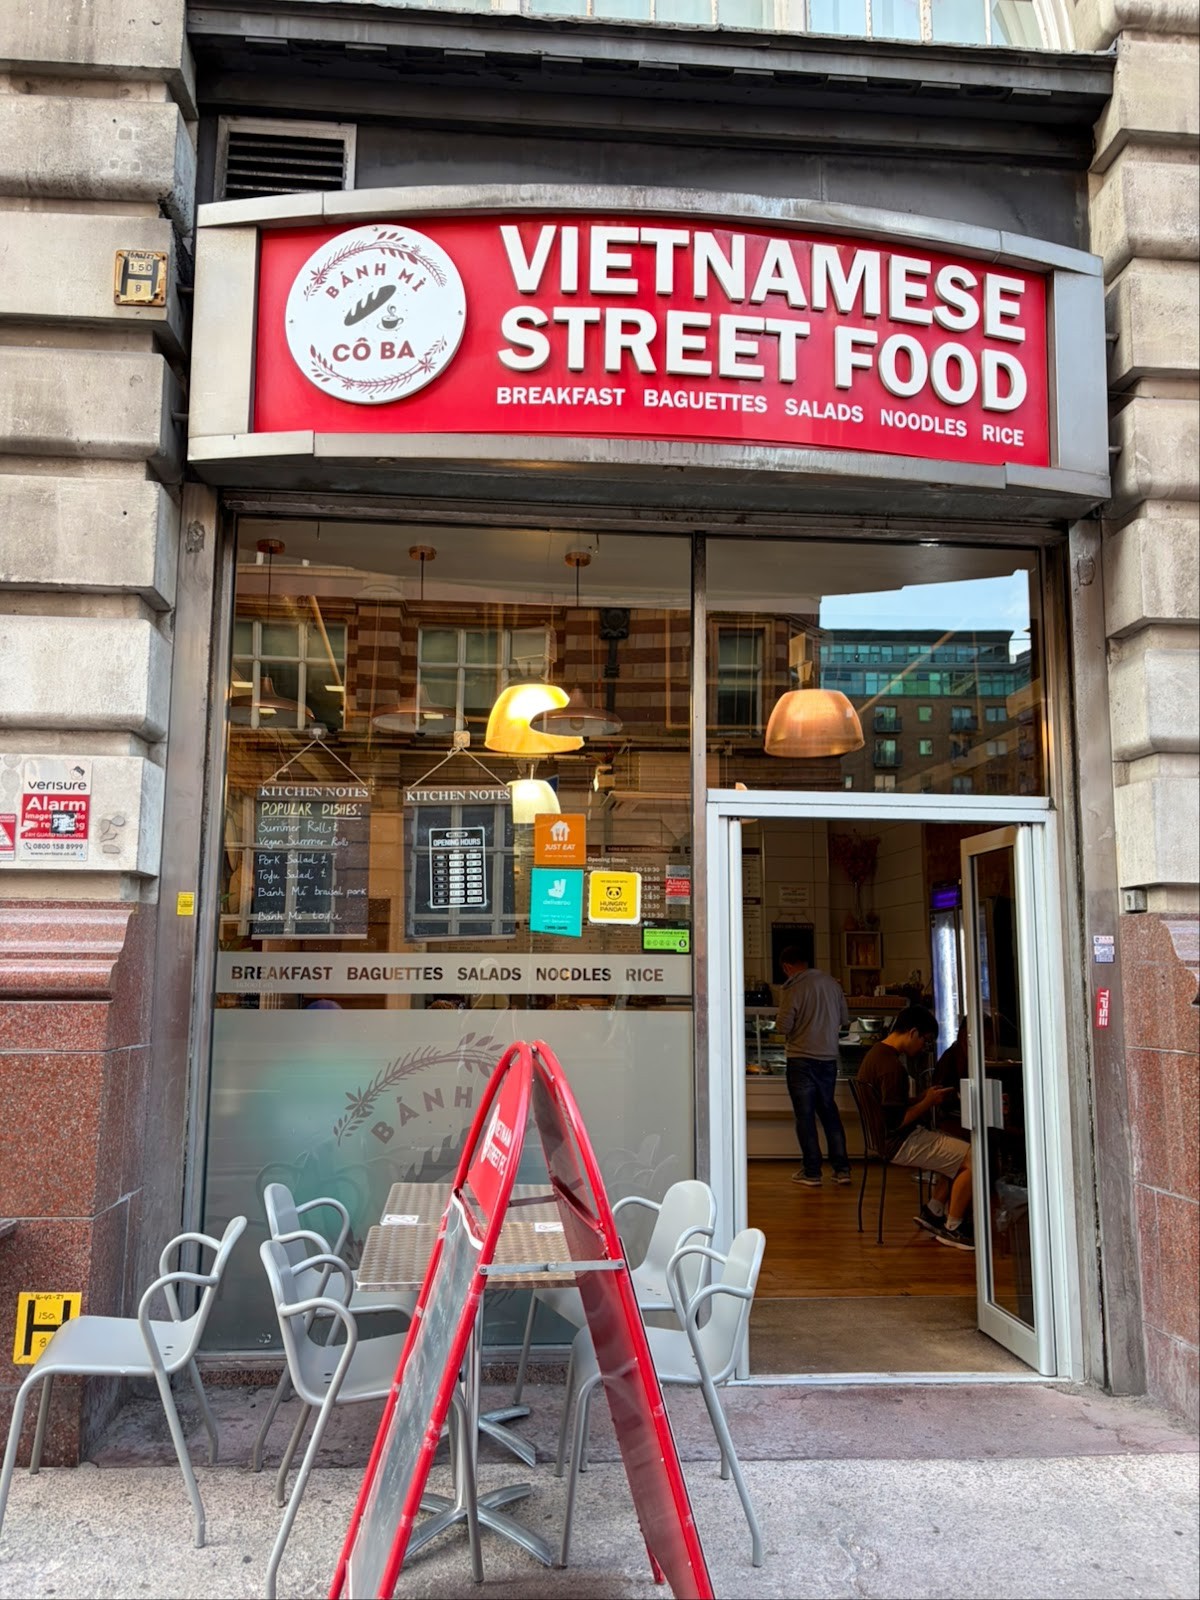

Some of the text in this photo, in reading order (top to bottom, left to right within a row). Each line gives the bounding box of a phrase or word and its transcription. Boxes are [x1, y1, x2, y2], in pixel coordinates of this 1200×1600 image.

[130, 263, 152, 272] 150
[500, 225, 1026, 343] VIETNAMESE
[332, 337, 415, 362] CÔ BA
[498, 305, 1028, 413] STREET FOOD
[496, 386, 1024, 447] BREAKFAST BAGUETTES SALADS NOODLES RICE
[28, 781, 87, 791] verisure
[261, 786, 368, 797] KITCHEN NOTES
[406, 789, 511, 802] KITCHEN NOTES
[26, 796, 86, 811] Alarm
[262, 802, 362, 816] POPULAR DISHES:
[258, 820, 300, 833] Summer
[307, 820, 332, 834] Rolls
[259, 836, 284, 849] Vegan
[286, 835, 327, 847] Summer
[433, 838, 481, 847] OPENING HOURS
[544, 843, 576, 851] JUST EAT
[285, 854, 319, 865] Salad
[258, 869, 280, 884] Tofu
[285, 869, 315, 879] Salad
[231, 966, 664, 982] BREAKFAST BAGUETTES SALADS NOODLES RICE
[371, 1086, 473, 1144] BÁNH
[38, 1312, 55, 1320] 150
[39, 1337, 47, 1348] 8
